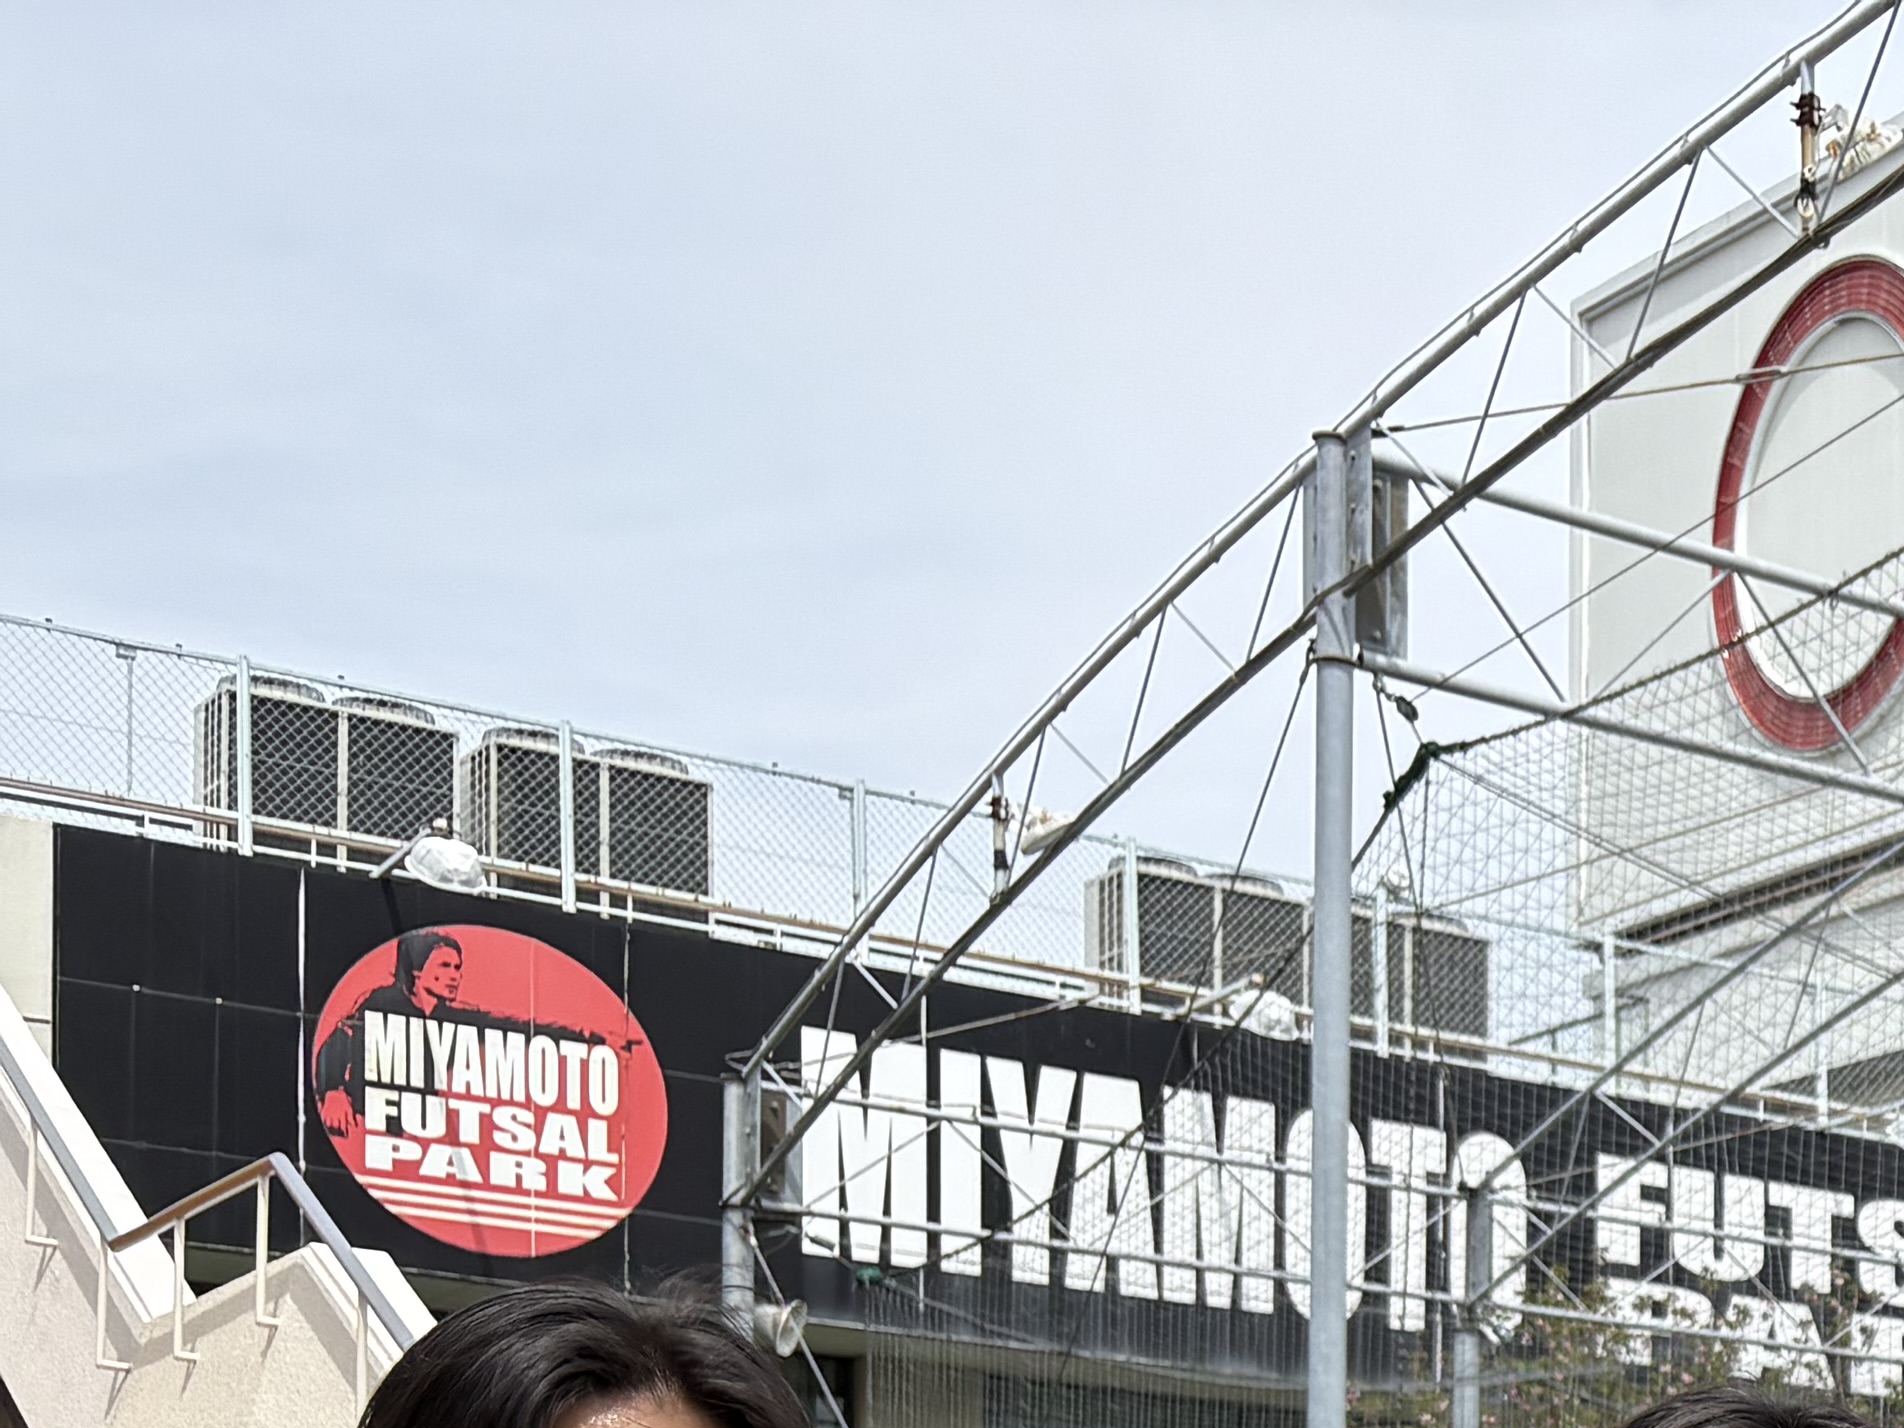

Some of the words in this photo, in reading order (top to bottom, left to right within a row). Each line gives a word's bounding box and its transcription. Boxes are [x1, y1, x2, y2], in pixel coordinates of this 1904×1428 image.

[364, 1011, 619, 1116] MIYAMOTO
[364, 1091, 619, 1165] FUTSAL
[364, 1131, 619, 1202] PARK
[801, 1026, 1528, 1336] MIYAMOTO
